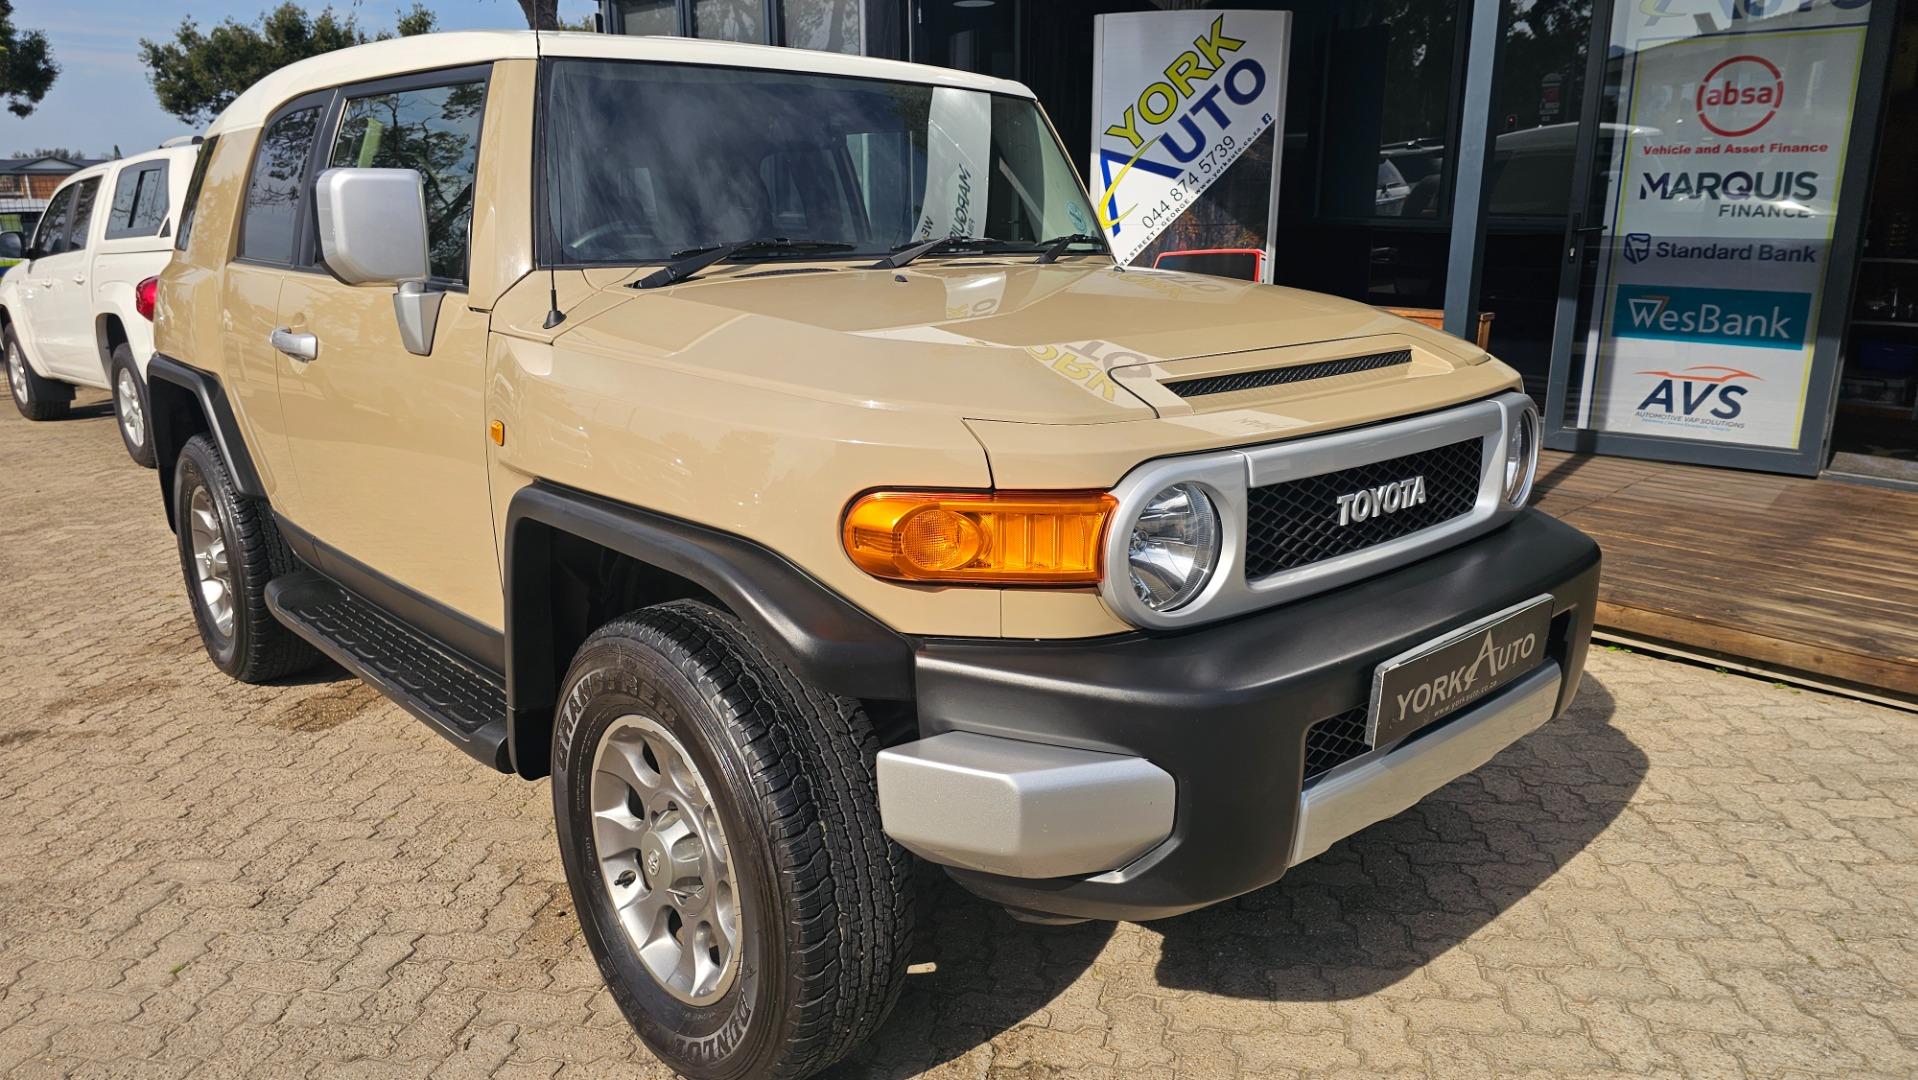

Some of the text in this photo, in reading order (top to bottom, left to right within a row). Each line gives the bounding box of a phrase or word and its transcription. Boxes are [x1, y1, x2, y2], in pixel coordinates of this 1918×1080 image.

[1104, 13, 1246, 149] YORK
[1706, 80, 1773, 107] absa
[1099, 58, 1266, 237] AUTO
[1643, 142, 1829, 156] Vehicle and Asset Finance
[1129, 231, 1156, 257] STREET
[1161, 199, 1191, 227] GEORGE
[1195, 127, 1262, 195] www.yorkauto.co.za
[1142, 135, 1236, 229] 044 874 5739
[1639, 170, 1818, 201] MARQUIS
[1656, 241, 1817, 263] Standard Bank
[1628, 297, 1792, 339] WesBank
[1634, 410, 1681, 422] AUTOMOTIVE
[1701, 418, 1745, 429] SOLUTIONS
[1637, 379, 1748, 420] AVS
[1336, 475, 1427, 526] TOYOTA
[1397, 629, 1536, 721] YORK AUTO
